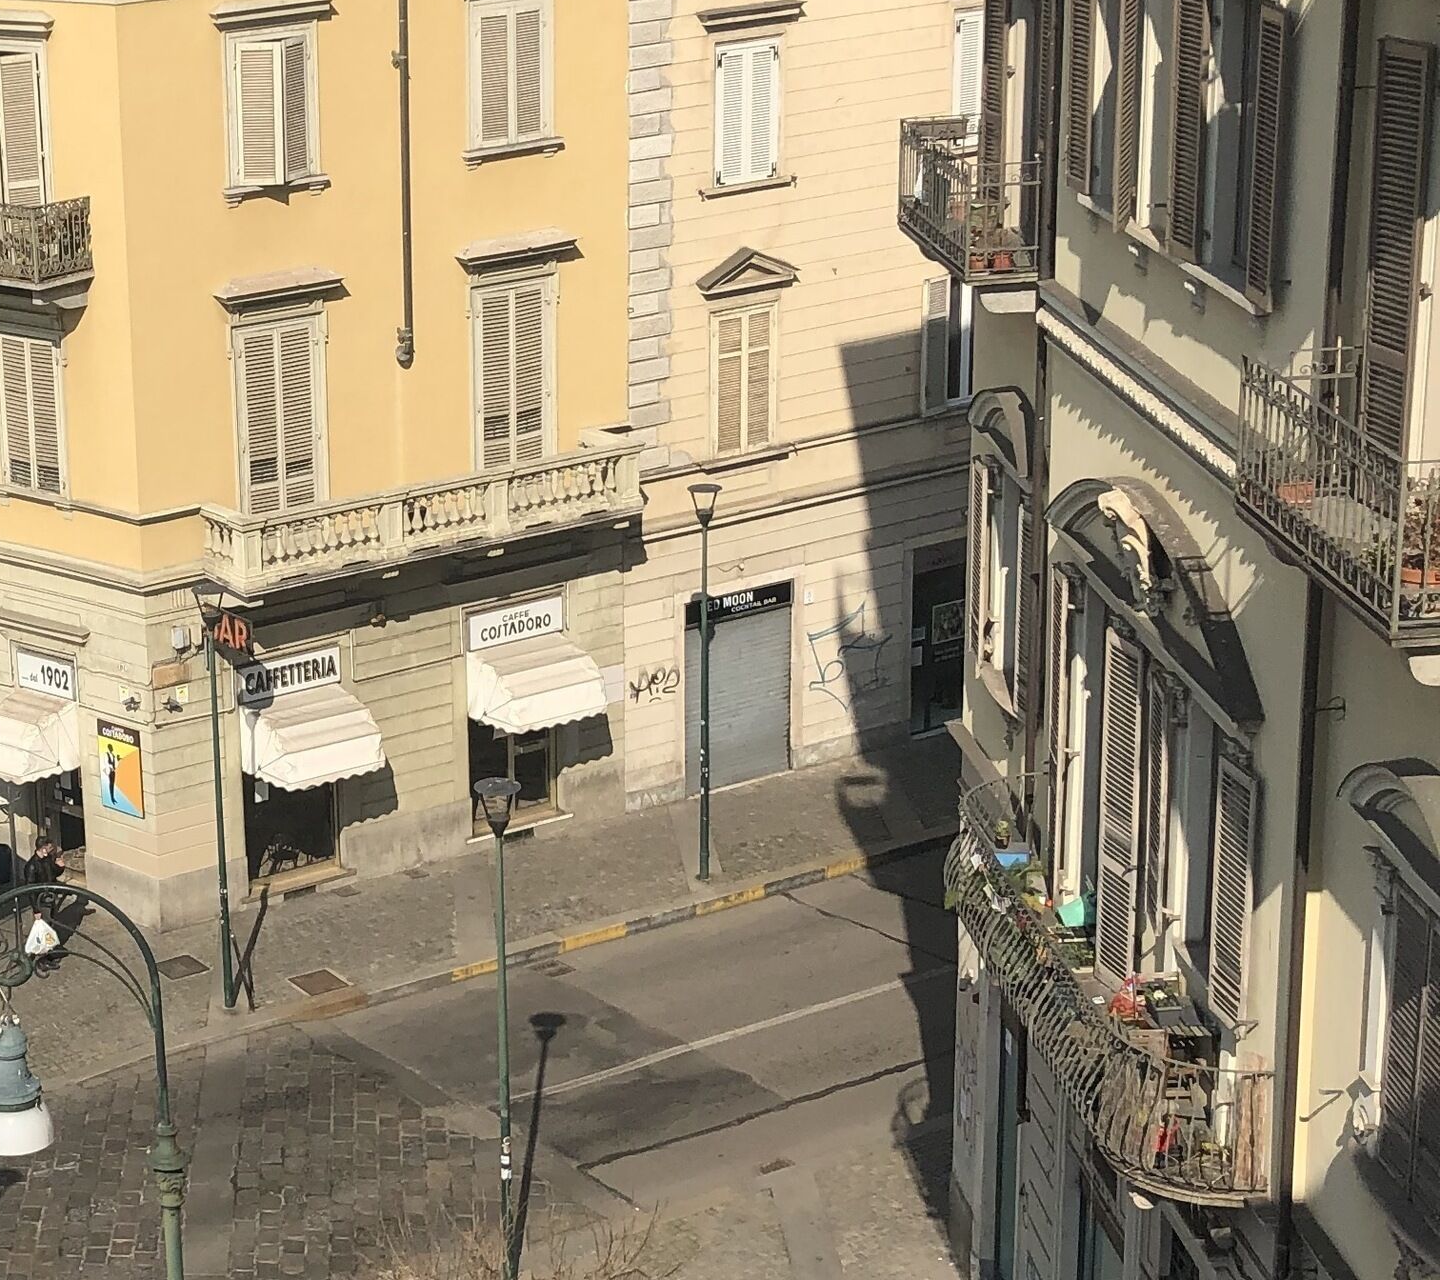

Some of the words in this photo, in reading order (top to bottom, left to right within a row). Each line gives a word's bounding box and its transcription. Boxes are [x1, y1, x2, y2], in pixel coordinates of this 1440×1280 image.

[723, 591, 754, 608] MOON
[731, 601, 762, 613] COCKTAIL
[480, 613, 552, 642] COSTADORO
[41, 664, 69, 691] 1902
[245, 655, 338, 696] CAFFETTERIA
